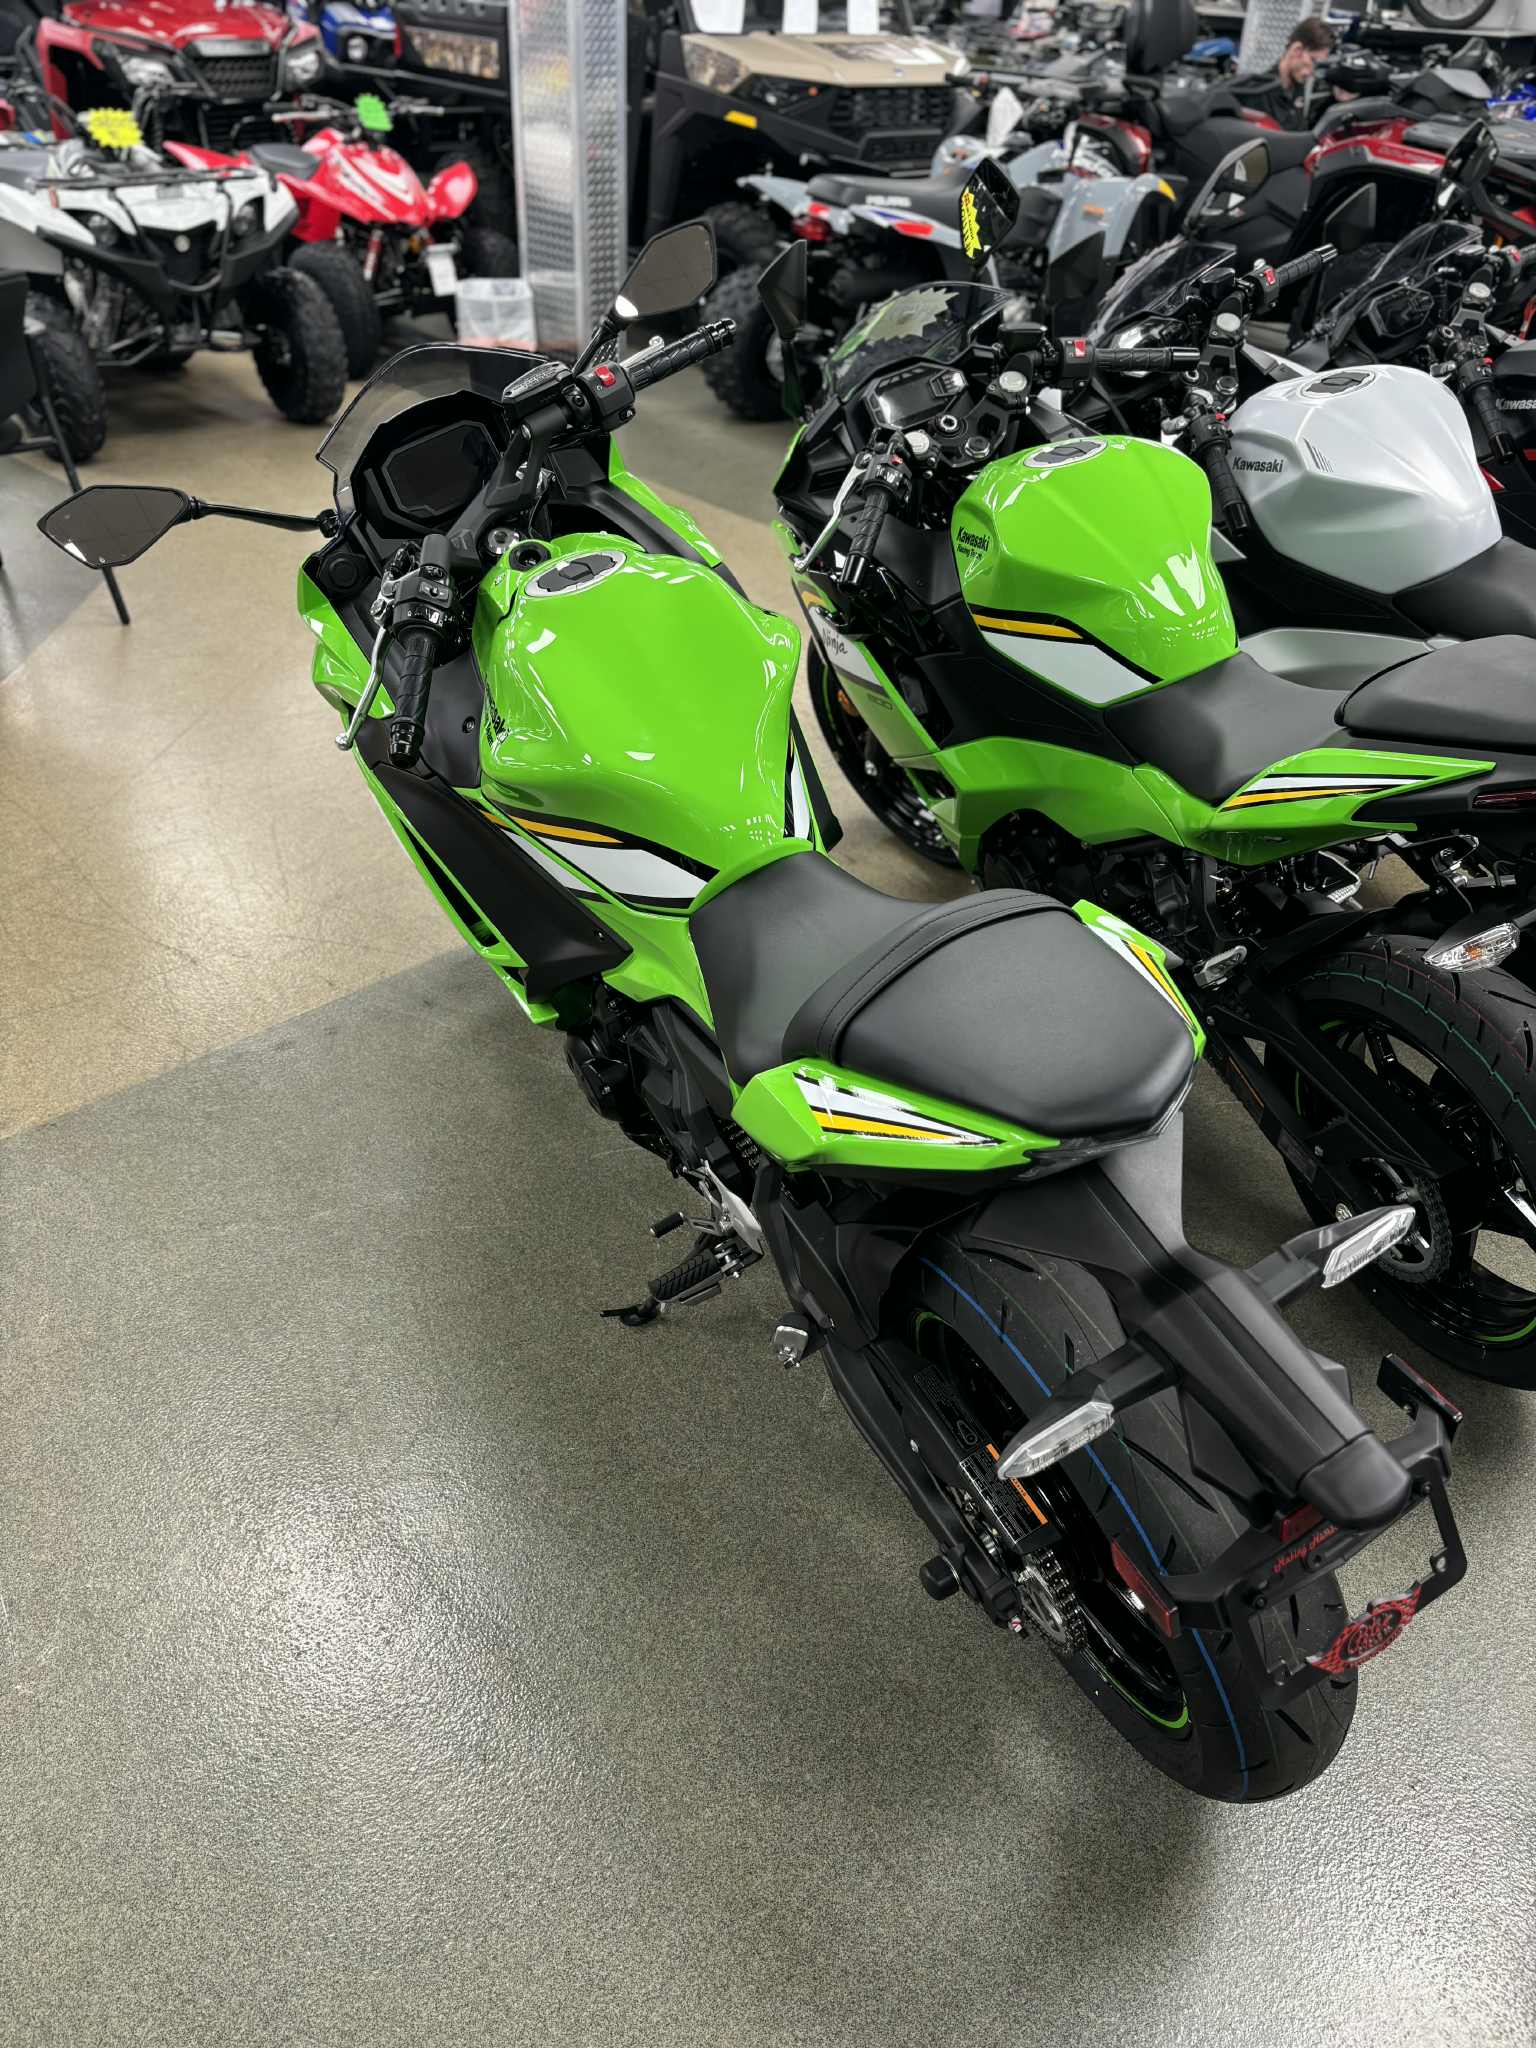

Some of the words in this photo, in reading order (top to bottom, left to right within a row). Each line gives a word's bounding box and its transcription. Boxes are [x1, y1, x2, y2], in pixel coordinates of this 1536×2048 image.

[1232, 457, 1284, 473] Kawasaki
[957, 526, 990, 551] Kawasaki
[822, 627, 848, 655] Ninja
